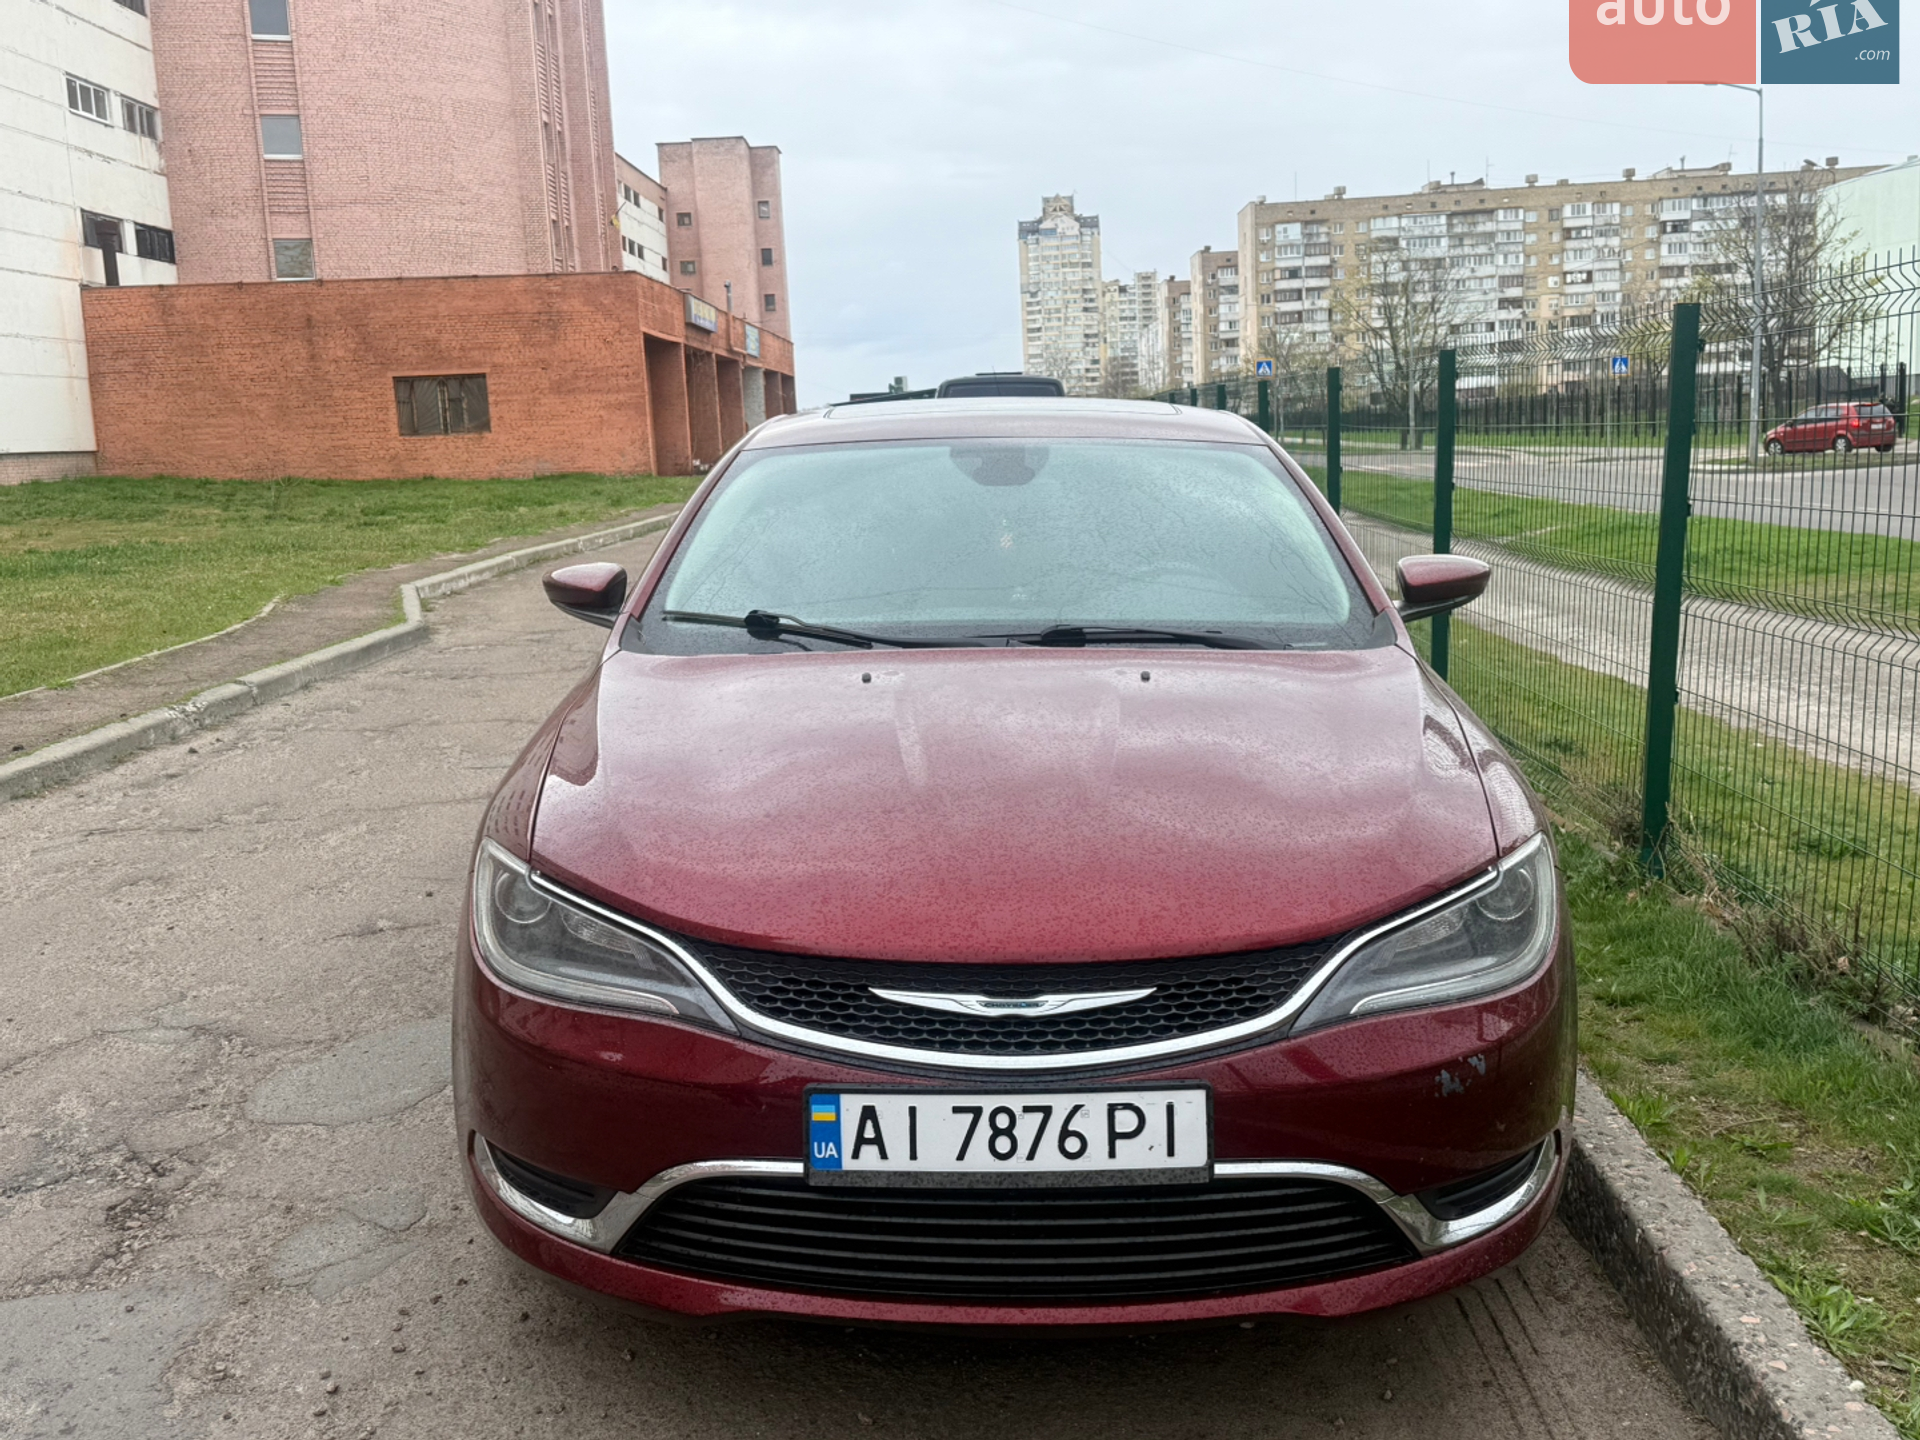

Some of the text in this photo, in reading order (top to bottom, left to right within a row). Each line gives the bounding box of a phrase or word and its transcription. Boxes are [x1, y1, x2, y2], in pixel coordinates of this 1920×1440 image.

[813, 1141, 839, 1159] UA
[851, 1101, 1176, 1161] AI 7876 PI
